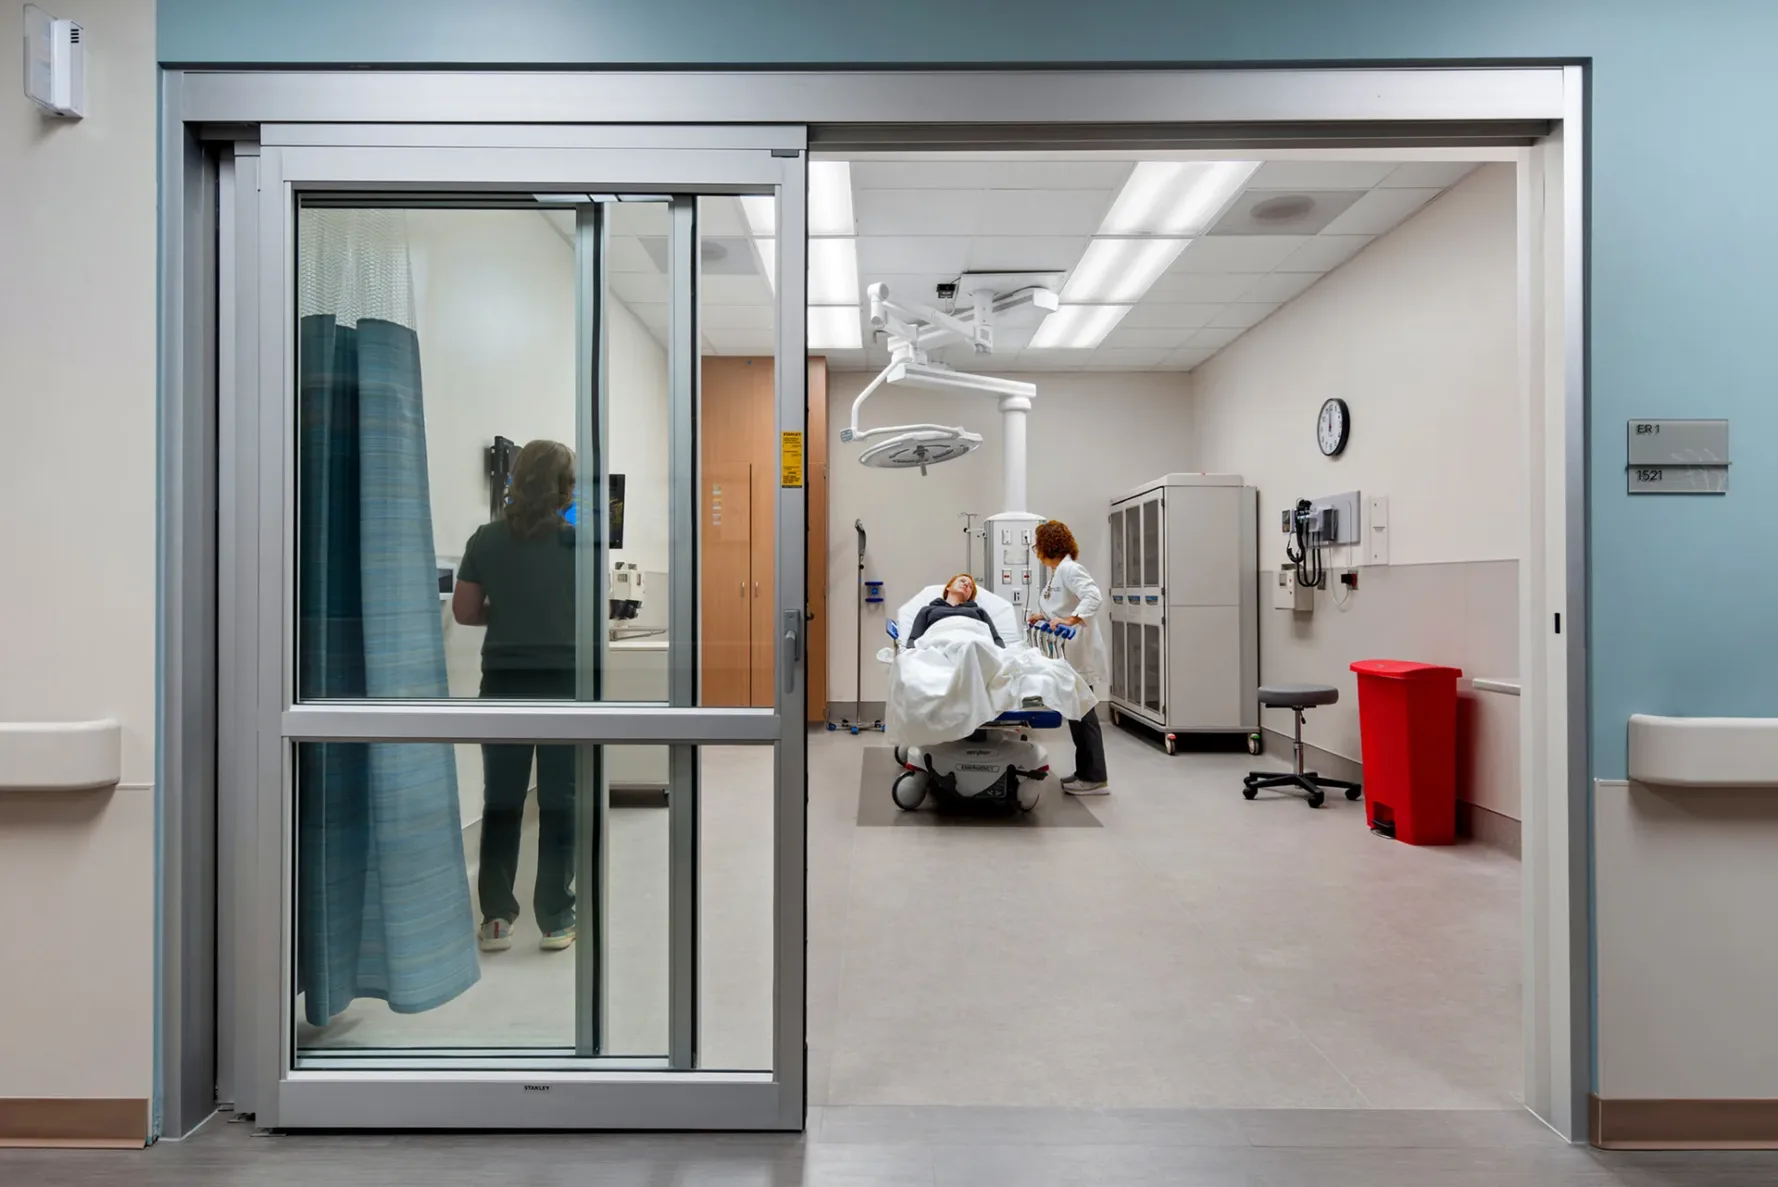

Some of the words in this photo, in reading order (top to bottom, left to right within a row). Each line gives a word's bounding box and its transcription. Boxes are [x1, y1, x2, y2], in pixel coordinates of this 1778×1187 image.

[1637, 424, 1653, 434] ER
[1654, 424, 1660, 434] 1
[1637, 469, 1663, 481] 1521
[961, 764, 994, 772] EMERGENCY
